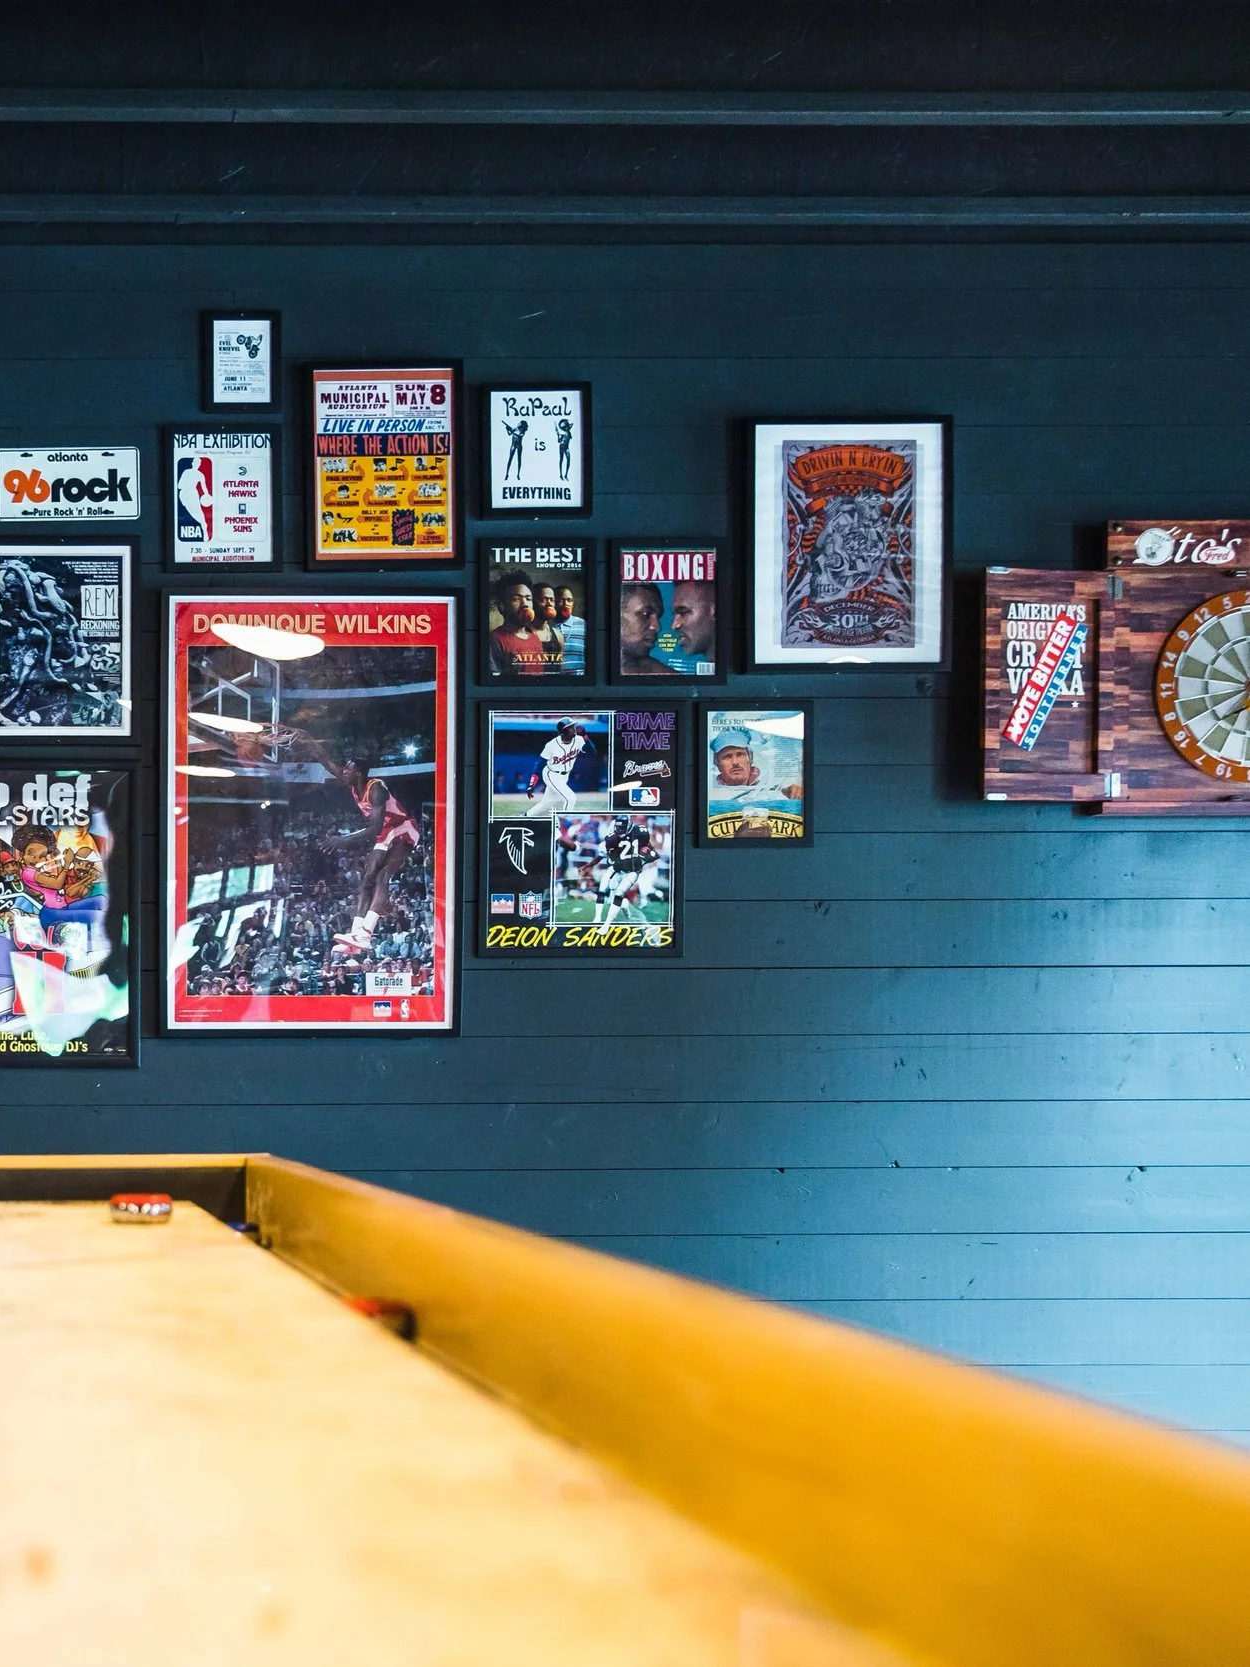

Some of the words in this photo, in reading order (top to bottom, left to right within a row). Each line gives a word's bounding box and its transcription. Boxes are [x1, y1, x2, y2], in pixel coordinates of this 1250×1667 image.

[320, 393, 390, 404] MUNICIPAL
[396, 393, 426, 405] MAY
[430, 384, 446, 405] 8
[323, 419, 356, 432] LIVE
[358, 419, 374, 432] IN
[376, 418, 426, 432] PERSON
[174, 434, 196, 448] NBA
[204, 434, 272, 448] EXHIBITION
[318, 435, 358, 455] WHERE
[362, 434, 382, 455] THE
[388, 434, 428, 455] ACTION
[433, 433, 449, 454] IS!
[535, 438, 546, 451] is
[47, 452, 88, 462] atlanta
[801, 451, 843, 474] DRIVIN
[848, 451, 856, 466] N
[862, 452, 898, 474] CRYIN
[223, 480, 258, 488] ATLANTA
[228, 490, 257, 498] HAWKS
[502, 487, 571, 500] EVERYTHING
[33, 508, 51, 516] Pure
[54, 508, 73, 516] Rock
[76, 507, 84, 516] 'n'
[87, 507, 103, 516] Roll
[180, 526, 202, 538] NBA
[492, 548, 531, 562] THE
[536, 548, 585, 562] BEST
[624, 554, 704, 580] BOXING
[824, 602, 875, 612] DECEMBER
[1223, 597, 1232, 609] 5
[830, 614, 868, 628] 30TH
[1193, 608, 1212, 624] 12
[81, 620, 119, 630] RECKONING
[334, 614, 432, 634] WILKINS
[1177, 630, 1190, 641] 9
[1162, 651, 1178, 668] 14
[1007, 685, 1041, 742] VOTE
[1031, 620, 1073, 688] BITTER
[1024, 630, 1086, 745] SOUTHERNER
[1160, 682, 1174, 698] 11
[616, 712, 675, 730] PRIME
[1164, 712, 1176, 721] 8
[622, 732, 670, 750] TIME
[1174, 731, 1190, 749] 16
[1194, 754, 1207, 766] 7
[623, 760, 664, 778] Braves
[1216, 763, 1232, 778] 19
[22, 774, 92, 808] def
[767, 819, 800, 838] ARK
[618, 839, 639, 860] 21
[522, 904, 539, 915] NFL
[487, 925, 557, 948] DEION
[564, 926, 674, 948] SANDERS
[374, 976, 403, 986] Gatorade
[66, 1040, 88, 1052] DJ's
